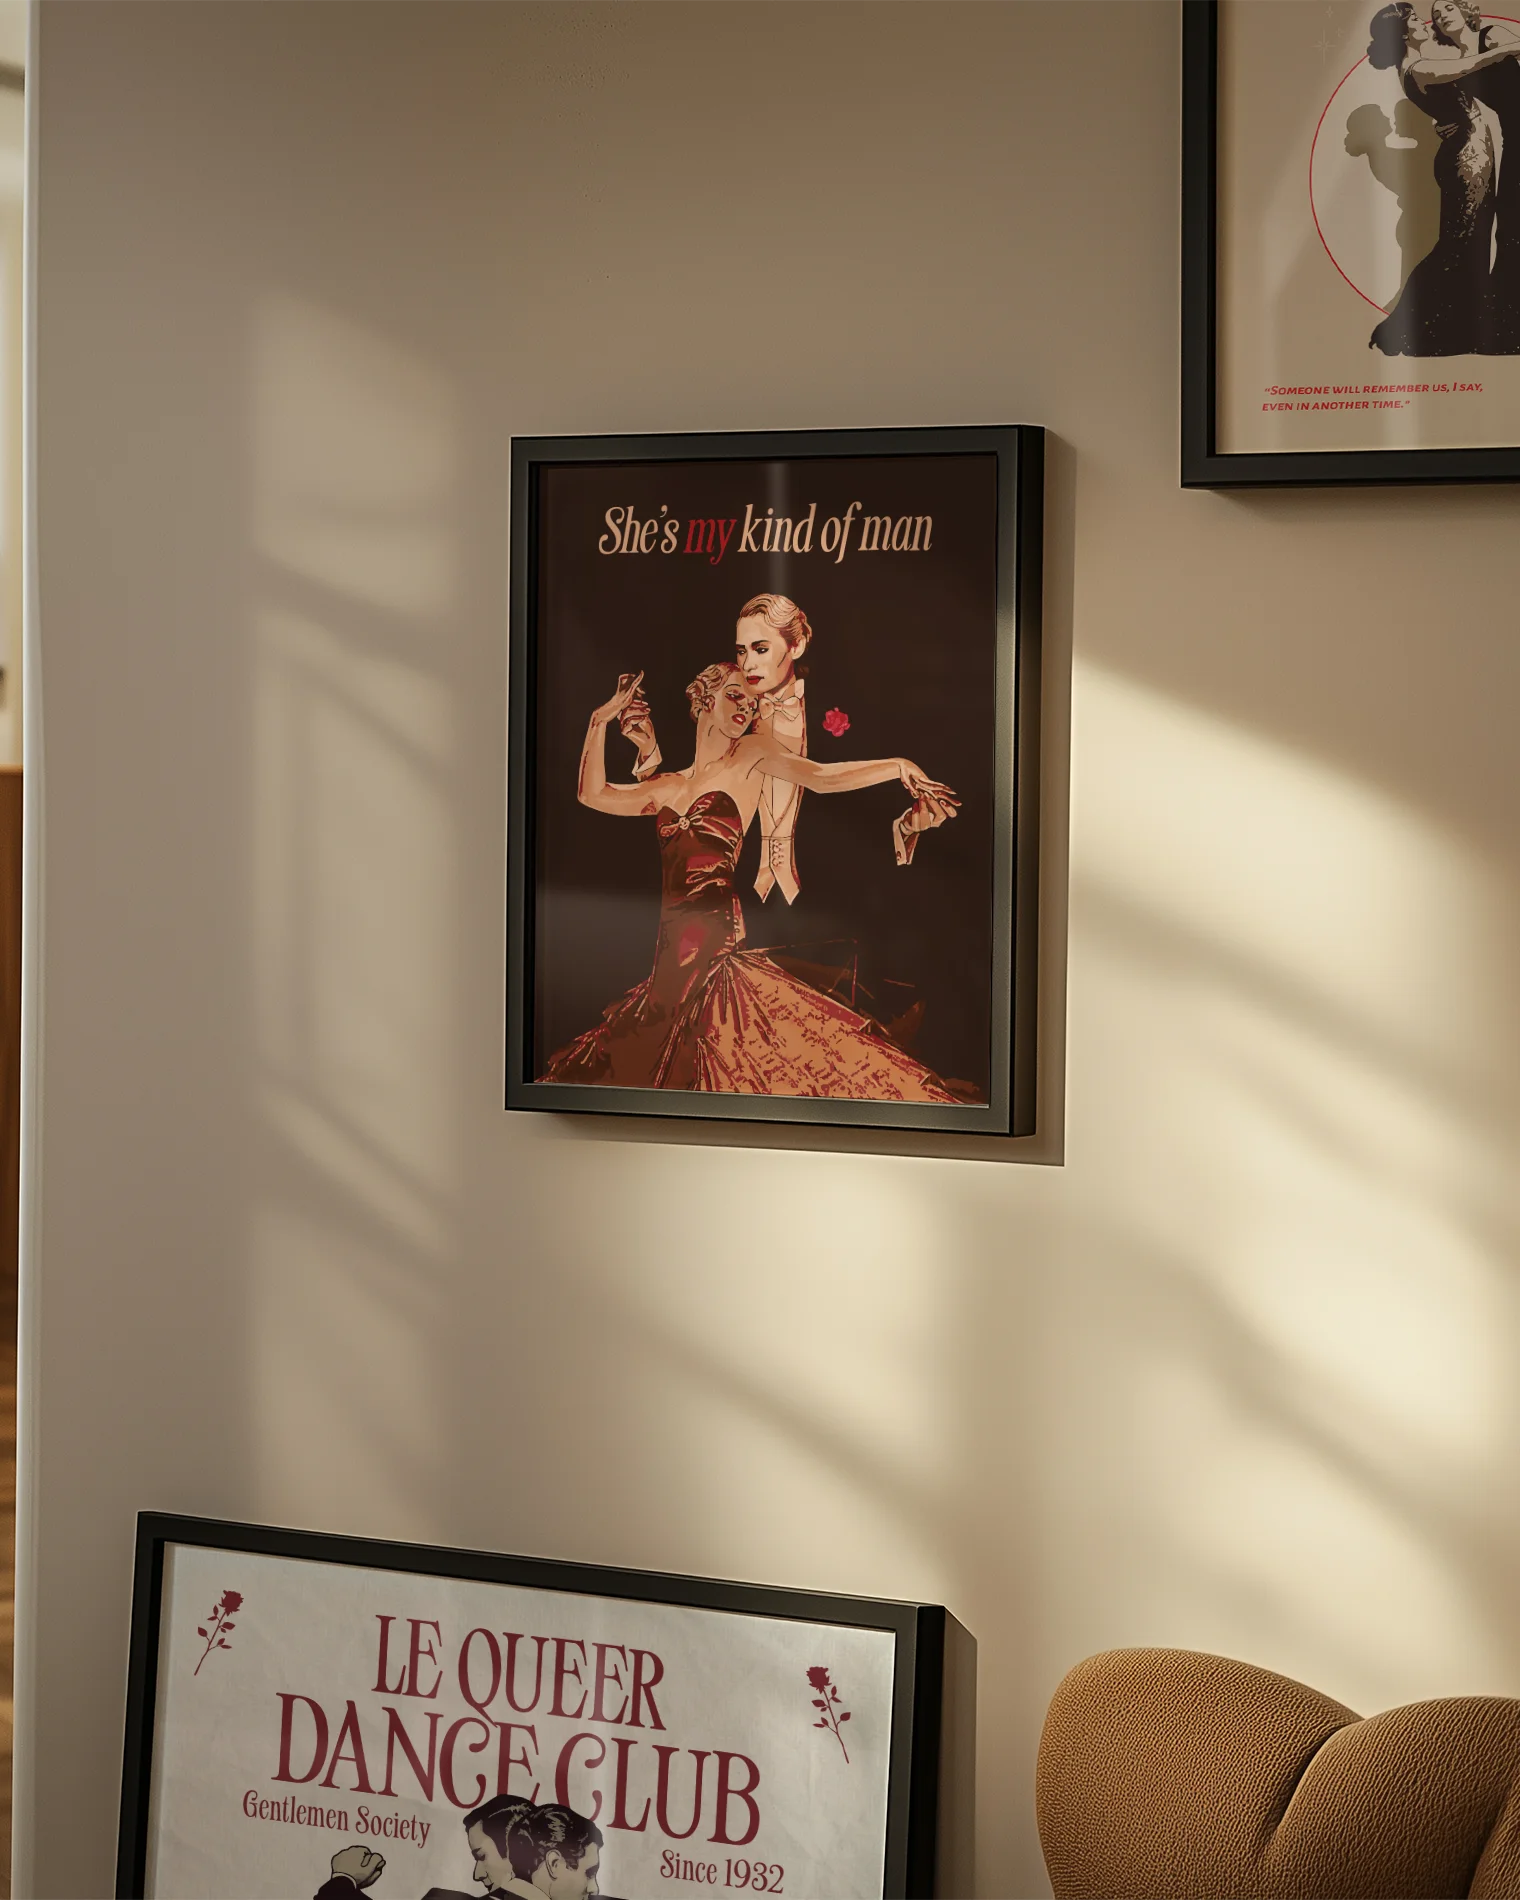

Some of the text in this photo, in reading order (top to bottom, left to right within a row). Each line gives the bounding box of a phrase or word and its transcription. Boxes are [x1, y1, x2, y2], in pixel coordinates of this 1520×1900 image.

[1262, 402, 1293, 412] EVEN
[1296, 402, 1310, 411] IN
[1312, 401, 1369, 410] ANOTHER
[1332, 385, 1361, 395] WILL
[1362, 383, 1429, 394] REMEMBER
[1432, 383, 1450, 393] US,
[1452, 382, 1458, 392] I
[1459, 383, 1484, 393] SAY,
[683, 518, 738, 566] my
[737, 503, 818, 554] kind
[820, 501, 863, 564] of
[857, 515, 934, 552] man
[371, 1614, 667, 1731] LE QUEER
[270, 1692, 761, 1847] DANCE CLUB
[242, 1789, 432, 1848] Gentlemen Society
[659, 1849, 785, 1894] Since 1932
